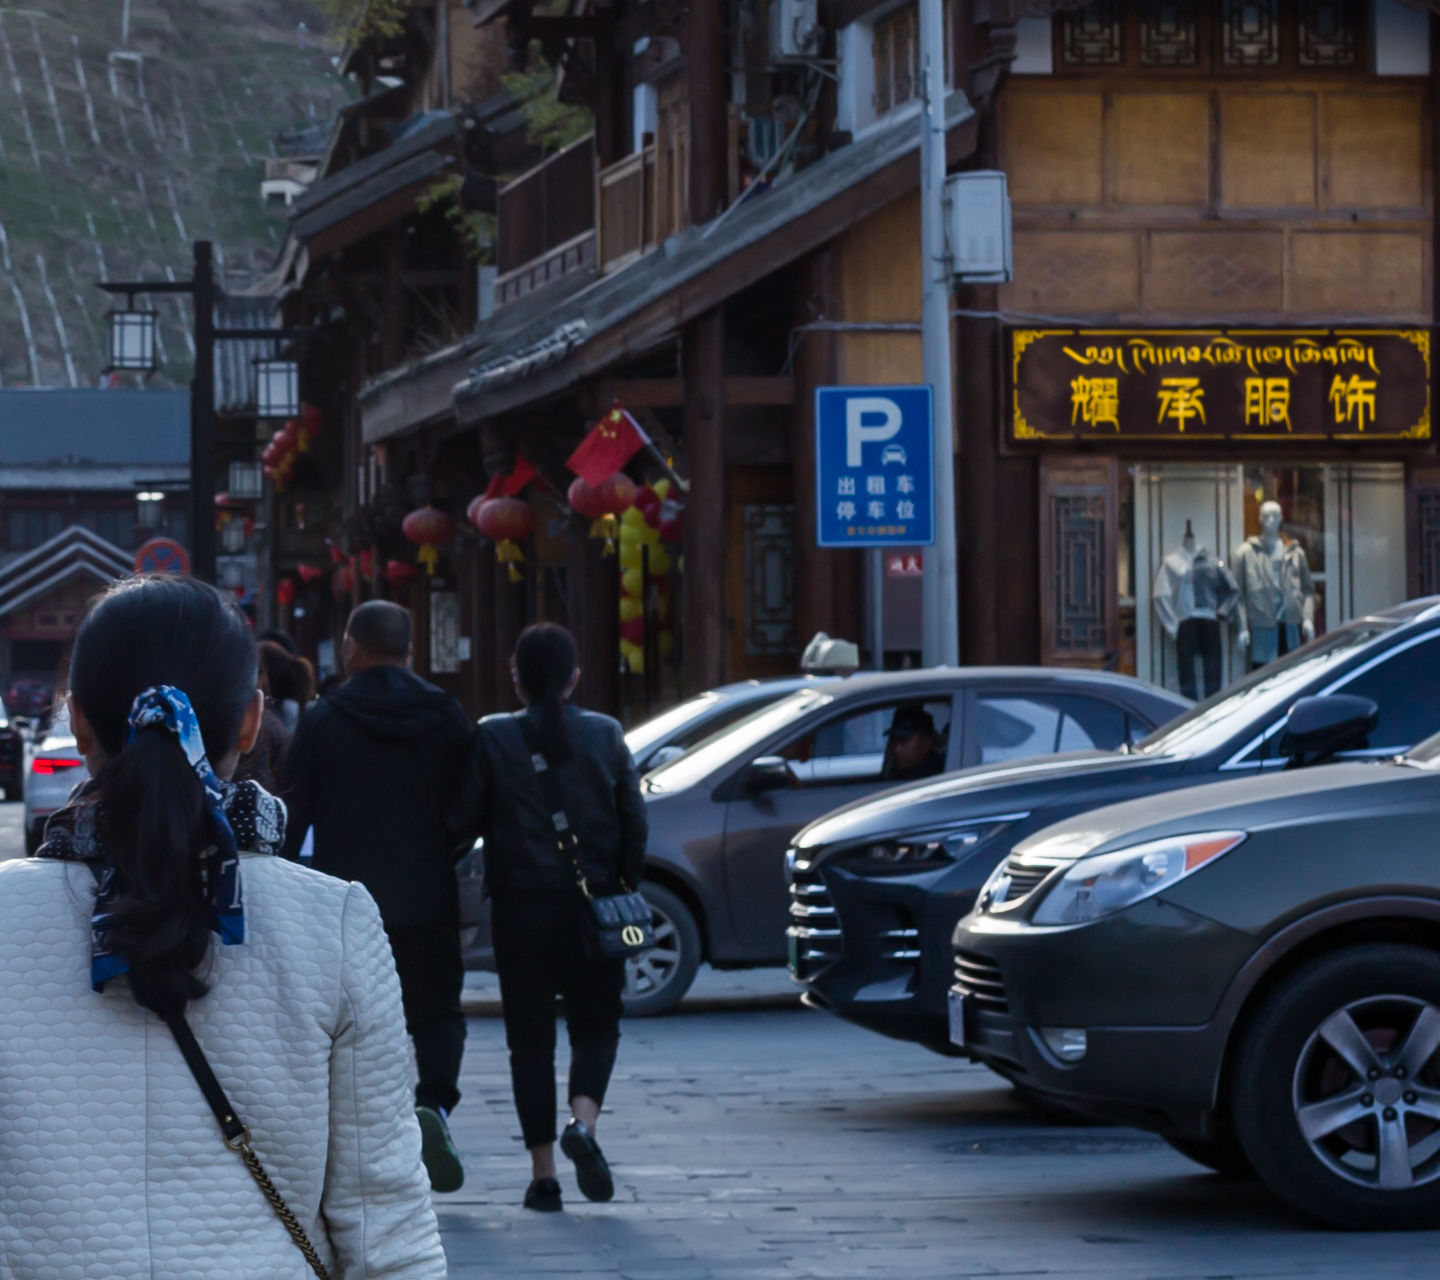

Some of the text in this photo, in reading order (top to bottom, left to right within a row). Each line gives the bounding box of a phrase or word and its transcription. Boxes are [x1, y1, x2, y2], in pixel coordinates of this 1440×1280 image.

[1070, 374, 1378, 432] 耀承服饰
[845, 396, 903, 468] P
[837, 474, 915, 495] 出租车
[836, 499, 915, 521] 停车位
